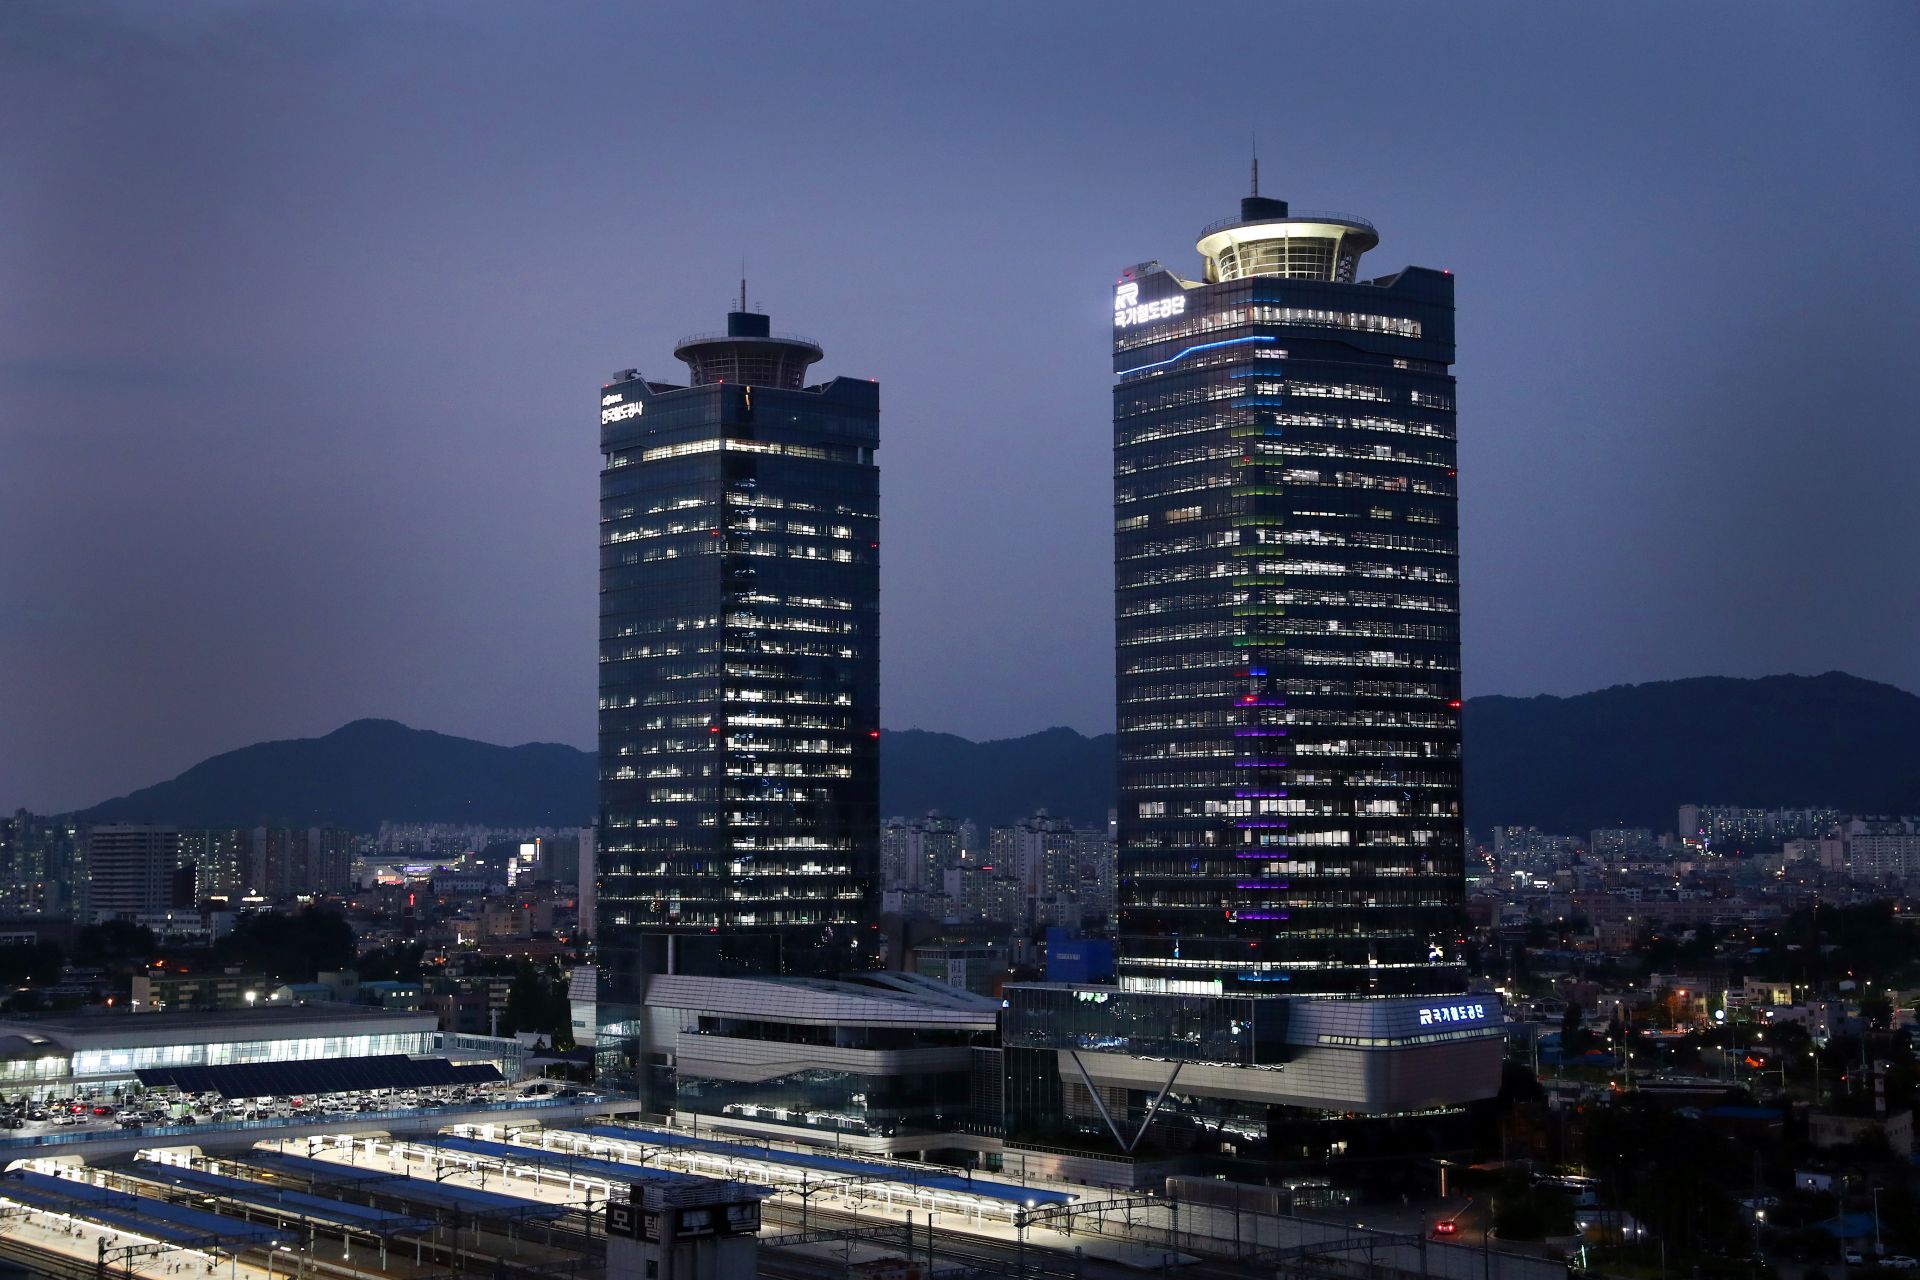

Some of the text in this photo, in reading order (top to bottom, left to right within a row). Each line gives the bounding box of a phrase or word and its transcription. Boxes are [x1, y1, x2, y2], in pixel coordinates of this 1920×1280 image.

[1114, 295, 1186, 328] 국가철도공단
[1432, 1004, 1485, 1023] 국가철도공단
[611, 1209, 660, 1239] 모텔
